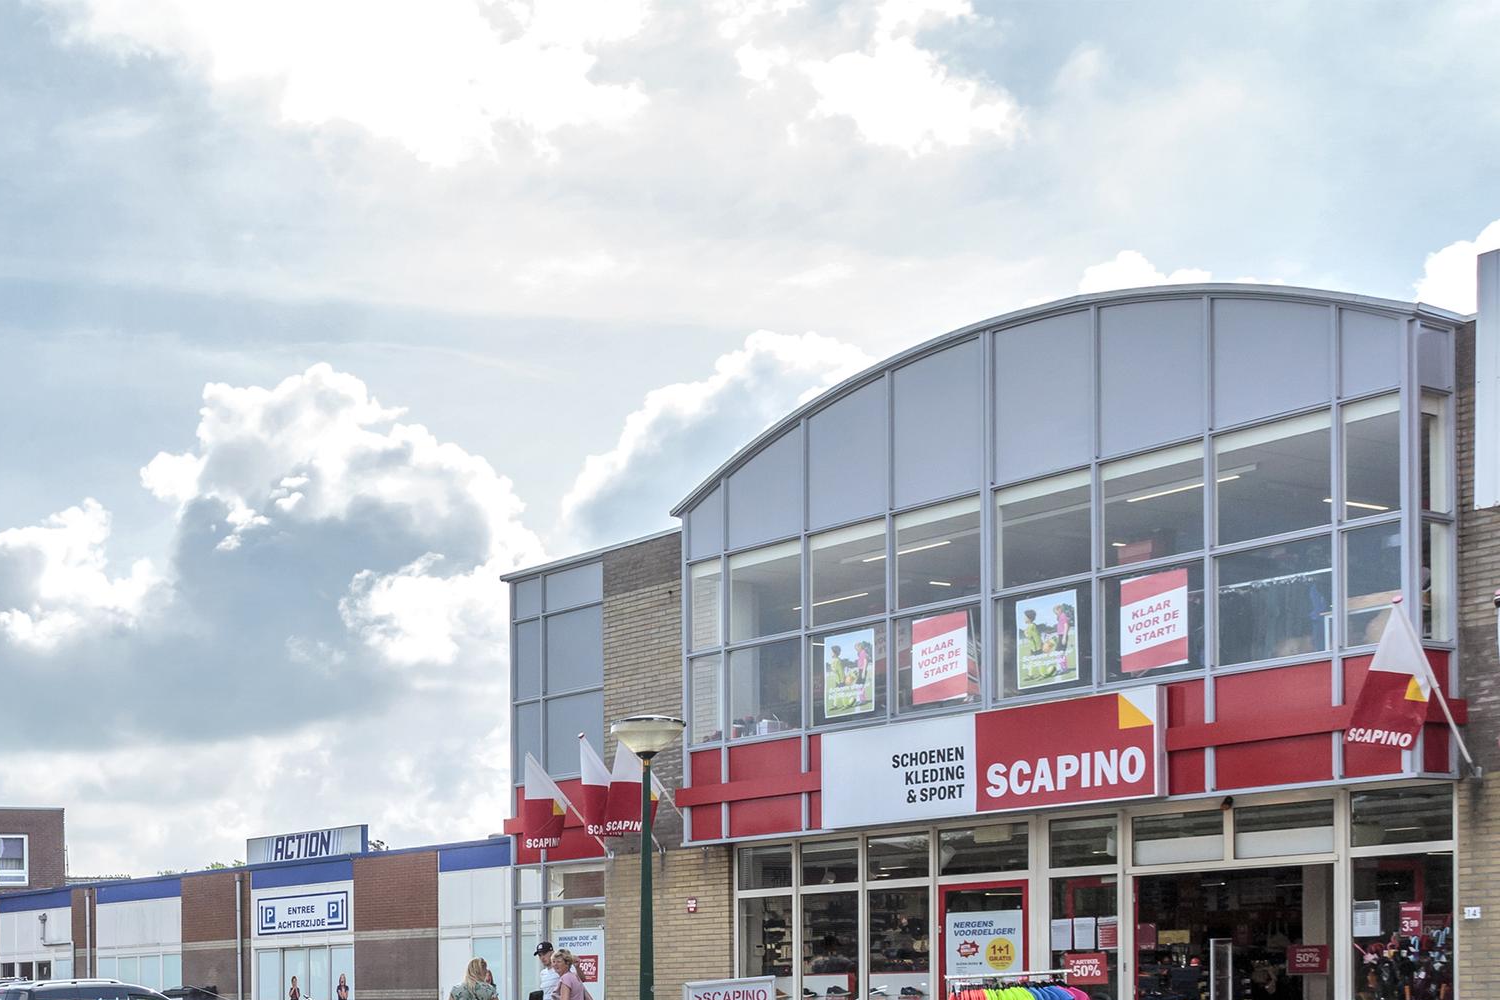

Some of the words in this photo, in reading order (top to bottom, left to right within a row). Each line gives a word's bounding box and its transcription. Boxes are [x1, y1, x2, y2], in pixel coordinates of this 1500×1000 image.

[1131, 599, 1171, 620] KLAAR
[1128, 616, 1160, 633] VOOR
[1163, 609, 1180, 622] DE
[1135, 623, 1176, 644] START!
[921, 638, 954, 656] KLAAR
[918, 653, 945, 669] VOOR
[947, 647, 961, 659] DE
[923, 661, 958, 679] START!
[1347, 727, 1412, 747] SCAPINO
[891, 746, 965, 769] SCHOENEN
[905, 765, 965, 786] KLEDING
[986, 746, 1146, 798] SCAPINO
[906, 789, 917, 804] &
[919, 784, 964, 803] SPORT
[606, 820, 642, 831] SCAPIN
[274, 831, 331, 861] ACTION
[266, 908, 273, 922] P
[287, 905, 315, 915] ENTREE
[328, 903, 337, 917] P
[277, 918, 326, 930] ACHTERZIJDE
[953, 920, 994, 929] NERGENS
[953, 927, 1016, 937] VOORDELIGER!
[991, 944, 1010, 955] 1+1
[1296, 953, 1320, 963] 50%
